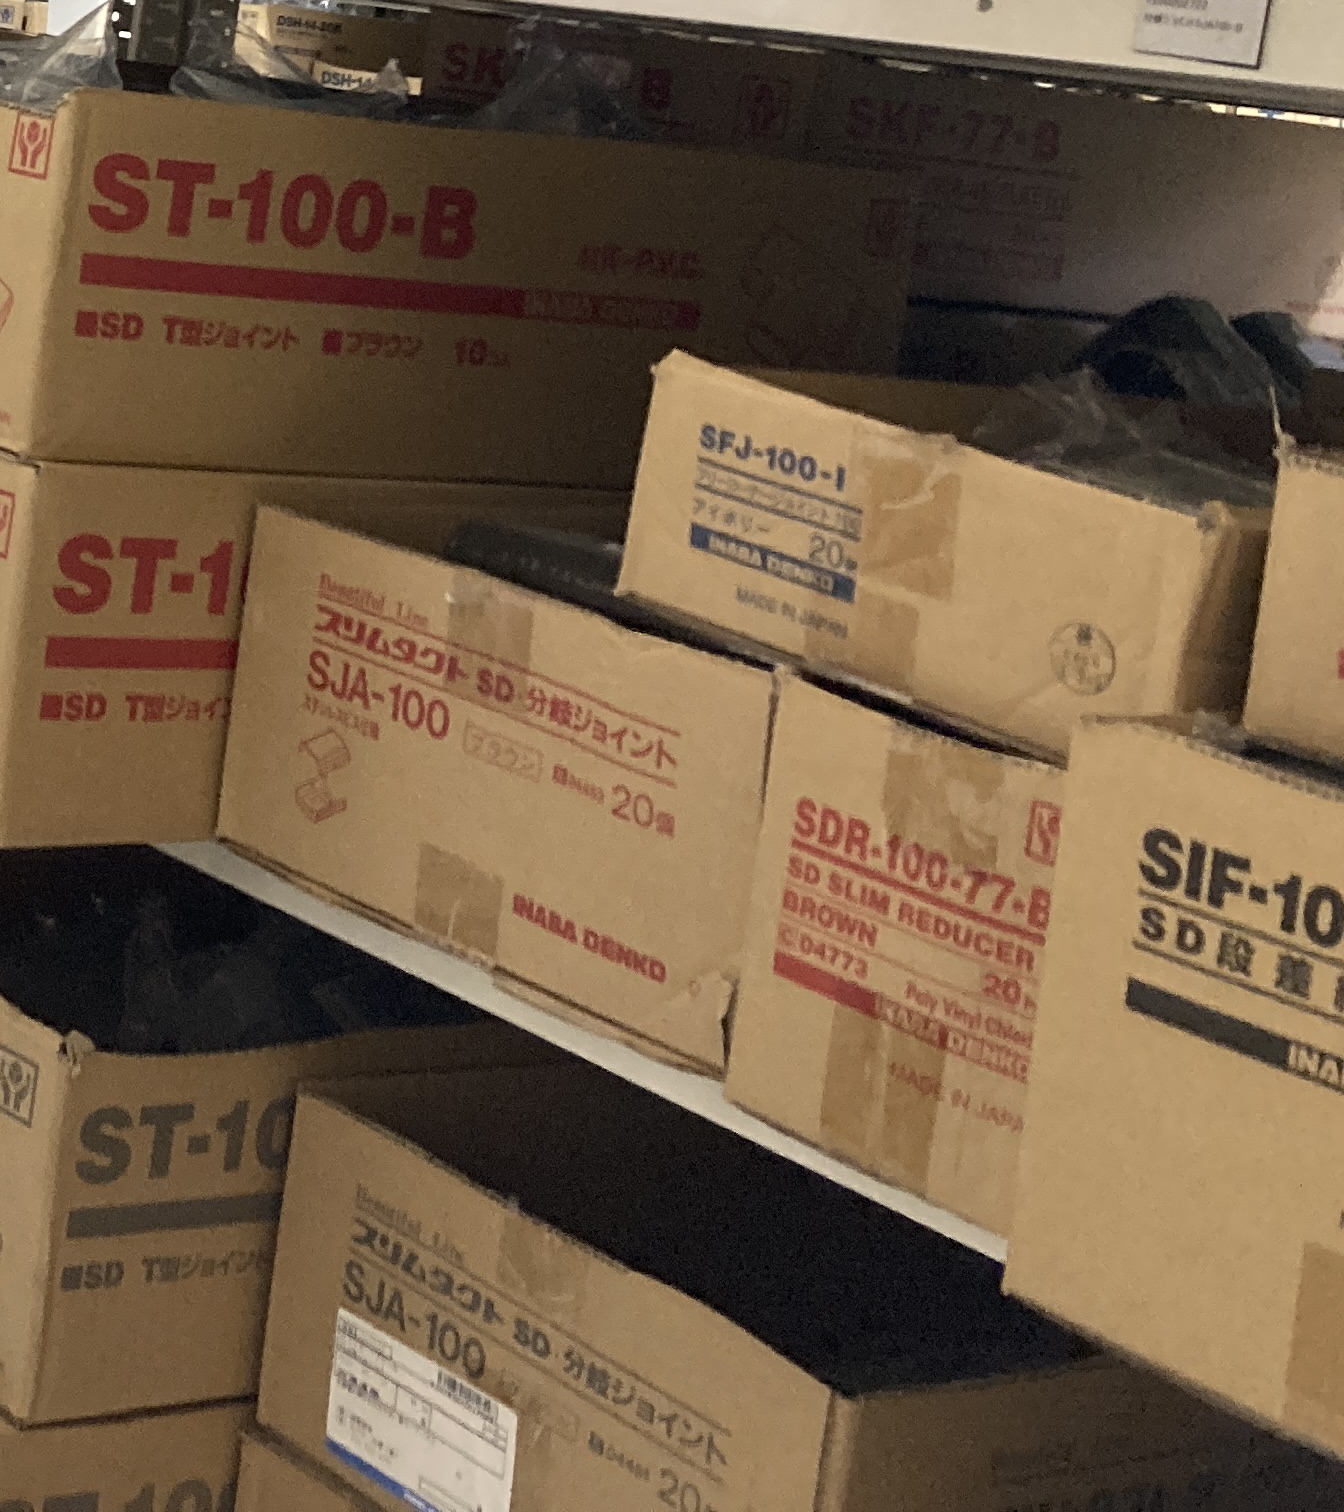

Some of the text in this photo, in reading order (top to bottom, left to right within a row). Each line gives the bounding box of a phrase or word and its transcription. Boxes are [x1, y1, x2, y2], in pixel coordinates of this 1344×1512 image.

[86, 152, 477, 259] ST-100-B
[100, 312, 144, 341] SD
[700, 424, 846, 491] SFJ-100-I
[61, 694, 107, 721] SD
[308, 650, 450, 740] SJA-100
[793, 796, 1051, 932] SDR-100-77-B
[1139, 826, 1344, 949] SIF-10
[512, 893, 666, 983] INABA DENKO
[782, 892, 879, 948] BROWN
[786, 856, 1036, 971] SD SLIM REDUCER
[1288, 1044, 1344, 1086] INA
[81, 1260, 123, 1289] SD
[343, 1260, 486, 1380] SJA-100
